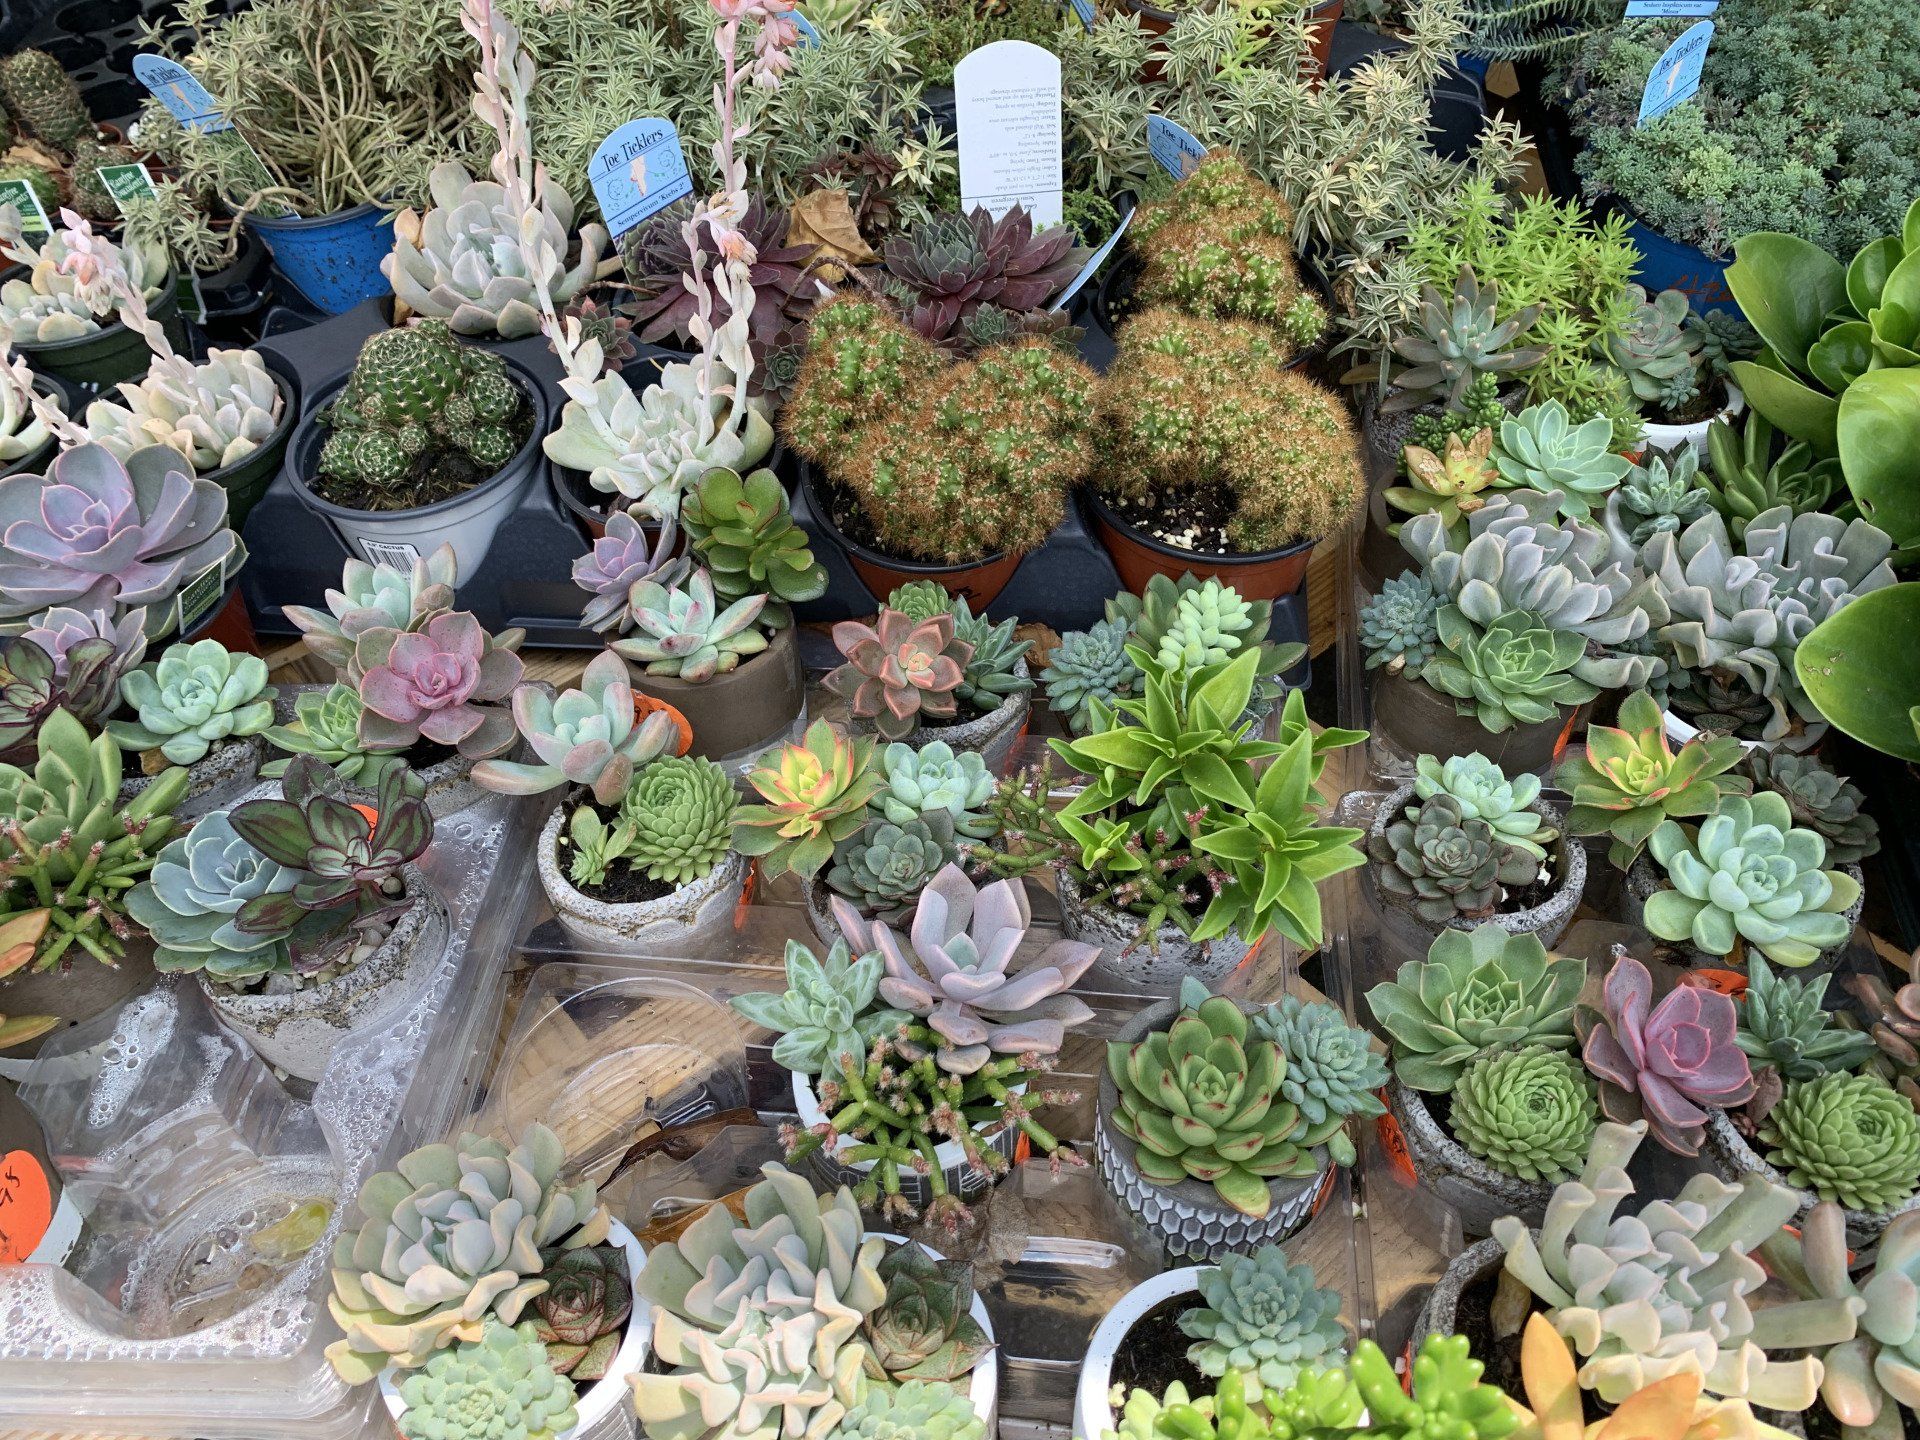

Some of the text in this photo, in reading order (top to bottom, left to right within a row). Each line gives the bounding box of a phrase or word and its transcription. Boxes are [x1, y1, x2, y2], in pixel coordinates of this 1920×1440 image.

[1659, 34, 1704, 75] Toe Ticklers
[141, 66, 180, 86] Toe Ticklers
[1161, 123, 1176, 141] Toe
[601, 128, 663, 172] Toe Ticklers
[618, 199, 658, 228] Sempervivum
